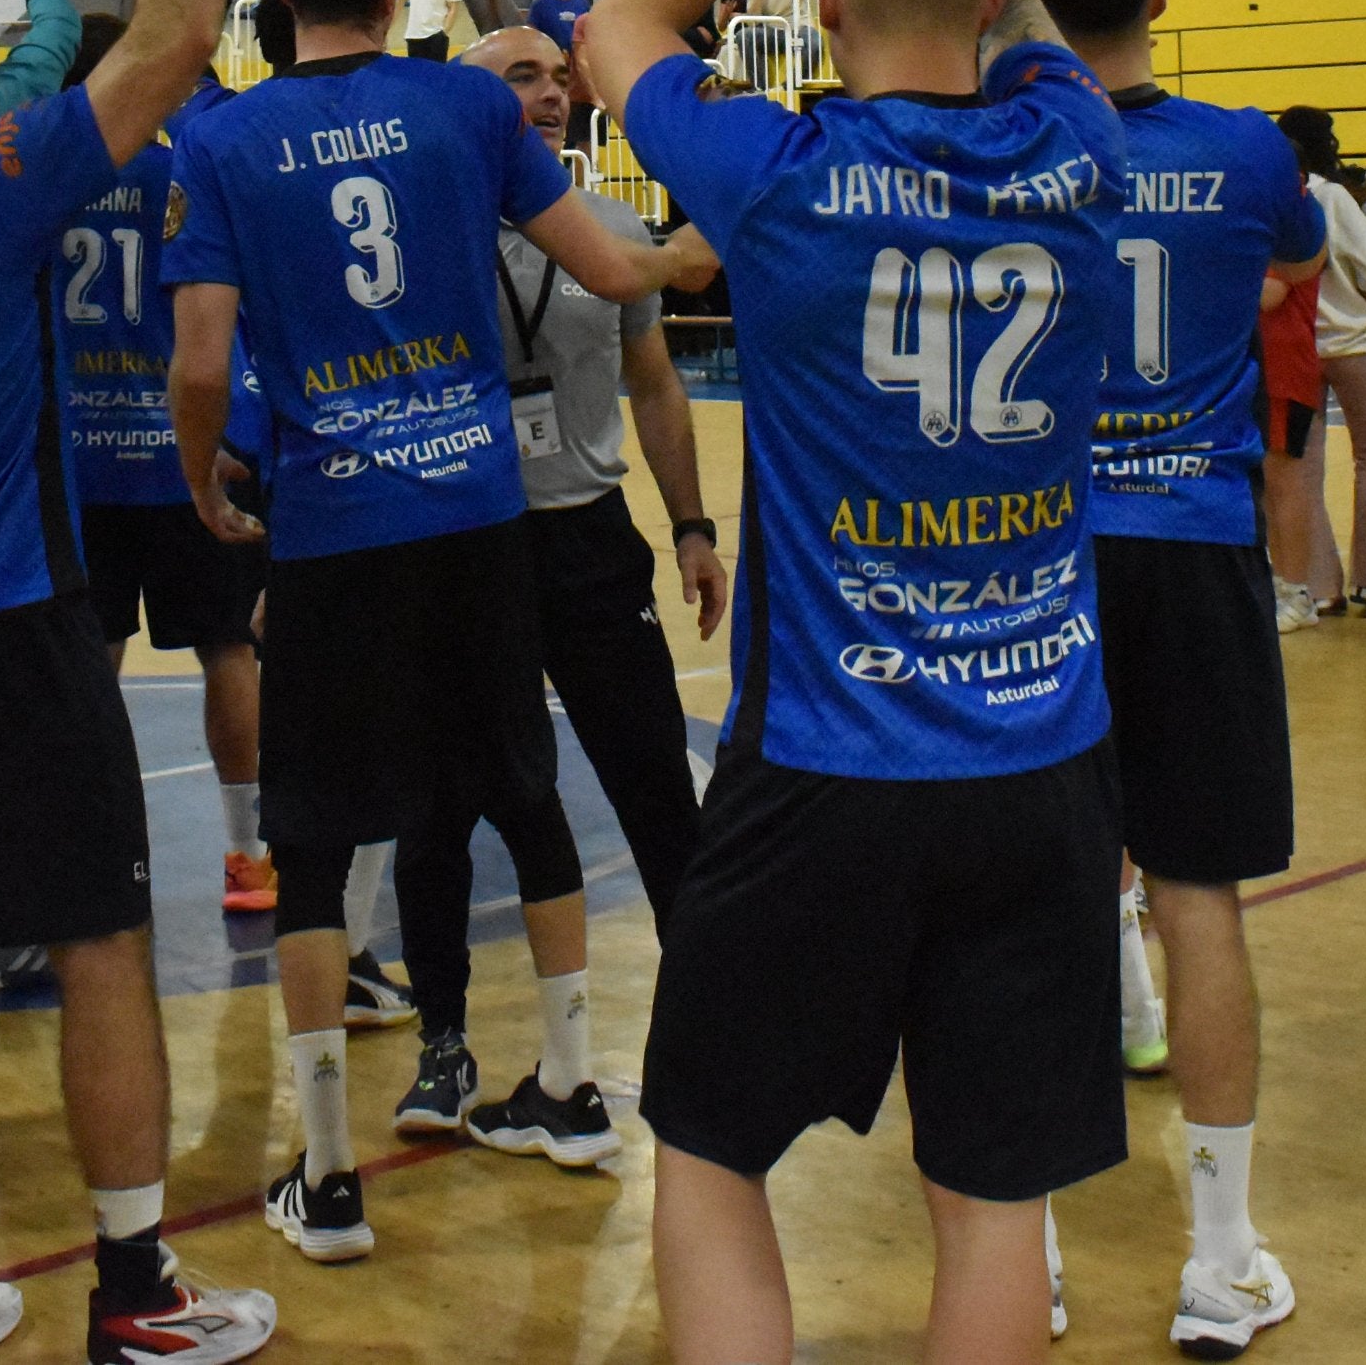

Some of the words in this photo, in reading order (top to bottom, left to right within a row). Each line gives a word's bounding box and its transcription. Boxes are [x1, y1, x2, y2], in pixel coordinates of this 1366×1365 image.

[278, 138, 308, 173] J.
[311, 118, 409, 166] COLÍAS
[814, 163, 951, 220] JAYRO
[986, 152, 1102, 218] PÉREZ
[331, 176, 405, 309] 3
[62, 227, 144, 326] 21
[304, 331, 472, 397] ALIMERKA
[862, 242, 1066, 448] 42
[87, 430, 177, 447] HYUNDA
[312, 383, 477, 435] GONZÁLEZ
[530, 421, 545, 441] E
[373, 423, 493, 469] HYUNDAI
[420, 458, 468, 480] Asturdai
[830, 480, 1074, 548] ALIMERKA
[837, 549, 1078, 615] GONZÁLEZ
[916, 612, 1097, 685] HYUNDAI
[986, 674, 1061, 707] Asturdai
